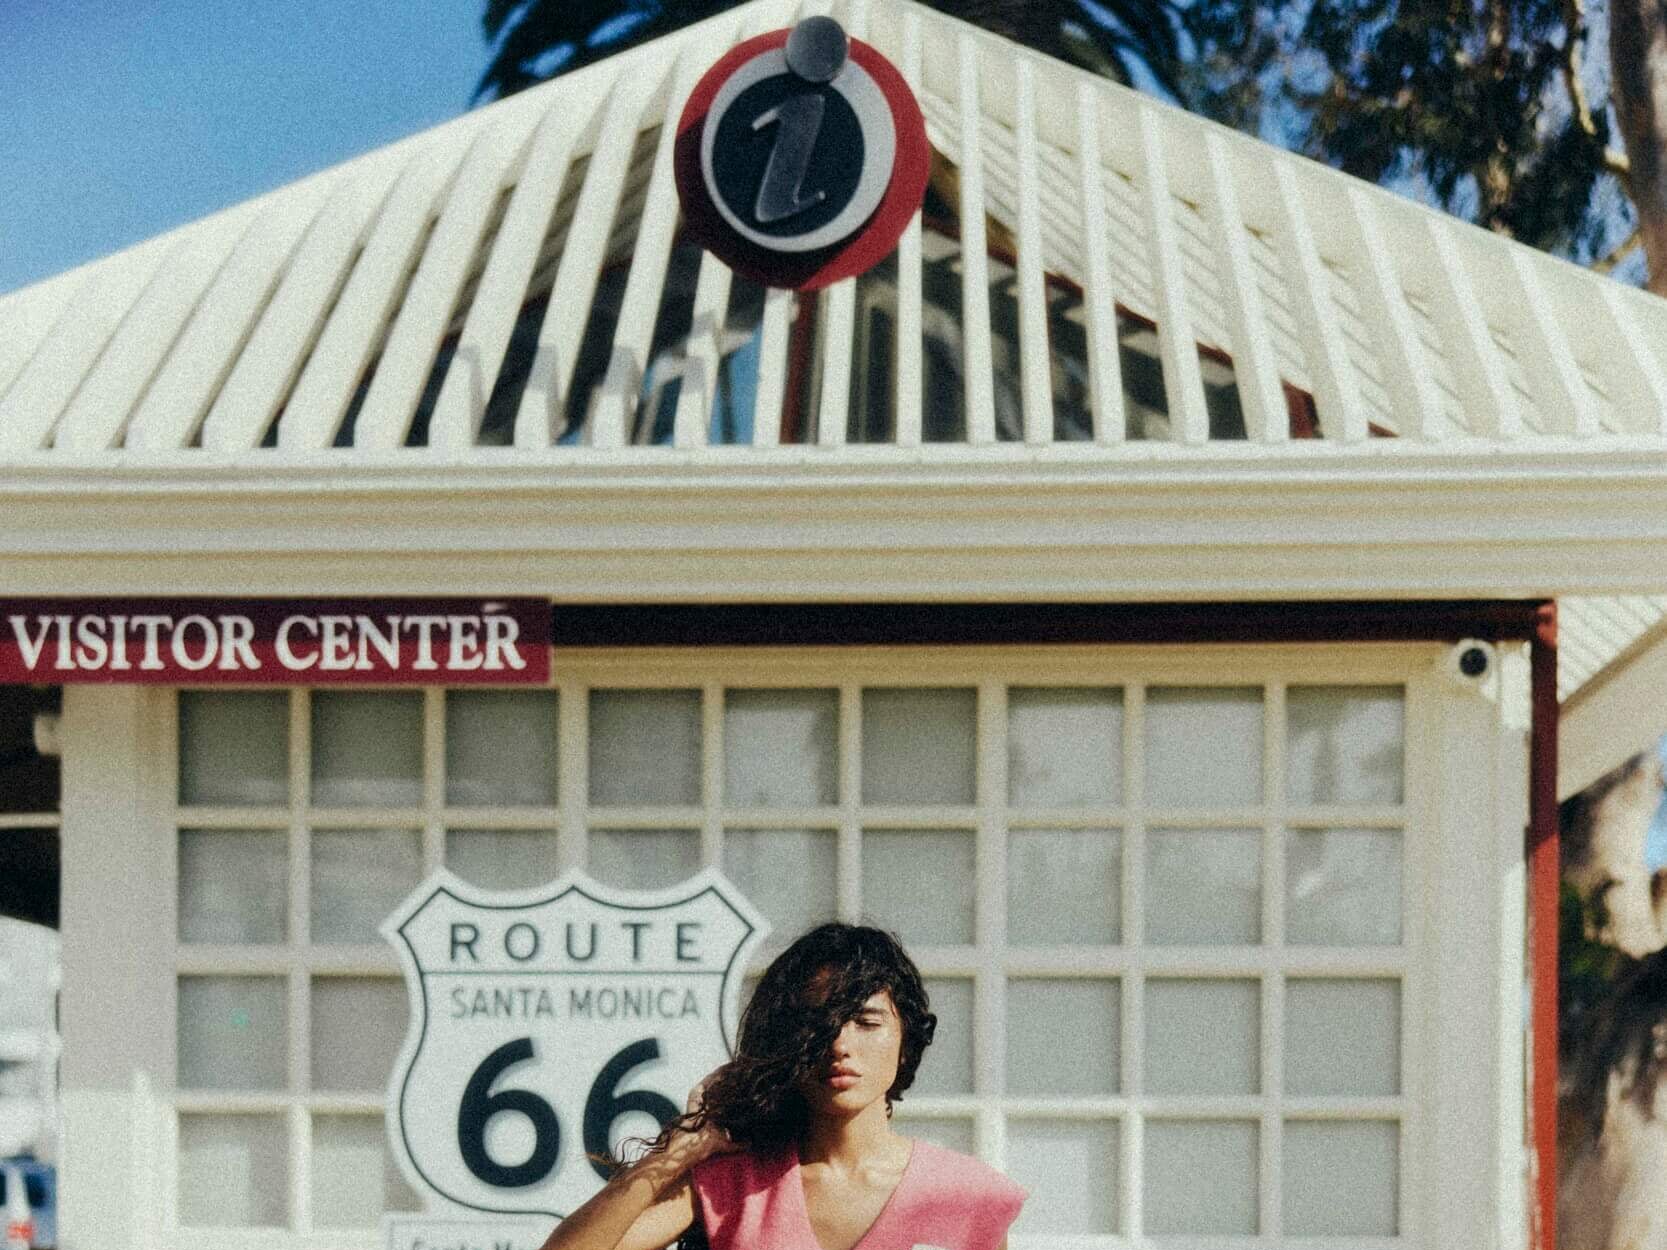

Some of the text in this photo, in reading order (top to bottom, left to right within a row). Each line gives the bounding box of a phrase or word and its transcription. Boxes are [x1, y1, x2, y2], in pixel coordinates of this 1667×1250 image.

[8, 614, 527, 671] VISITOR CENTER
[449, 921, 701, 963] ROUTE
[450, 985, 701, 1021] SANTA MONICA
[457, 1036, 682, 1189] 66
